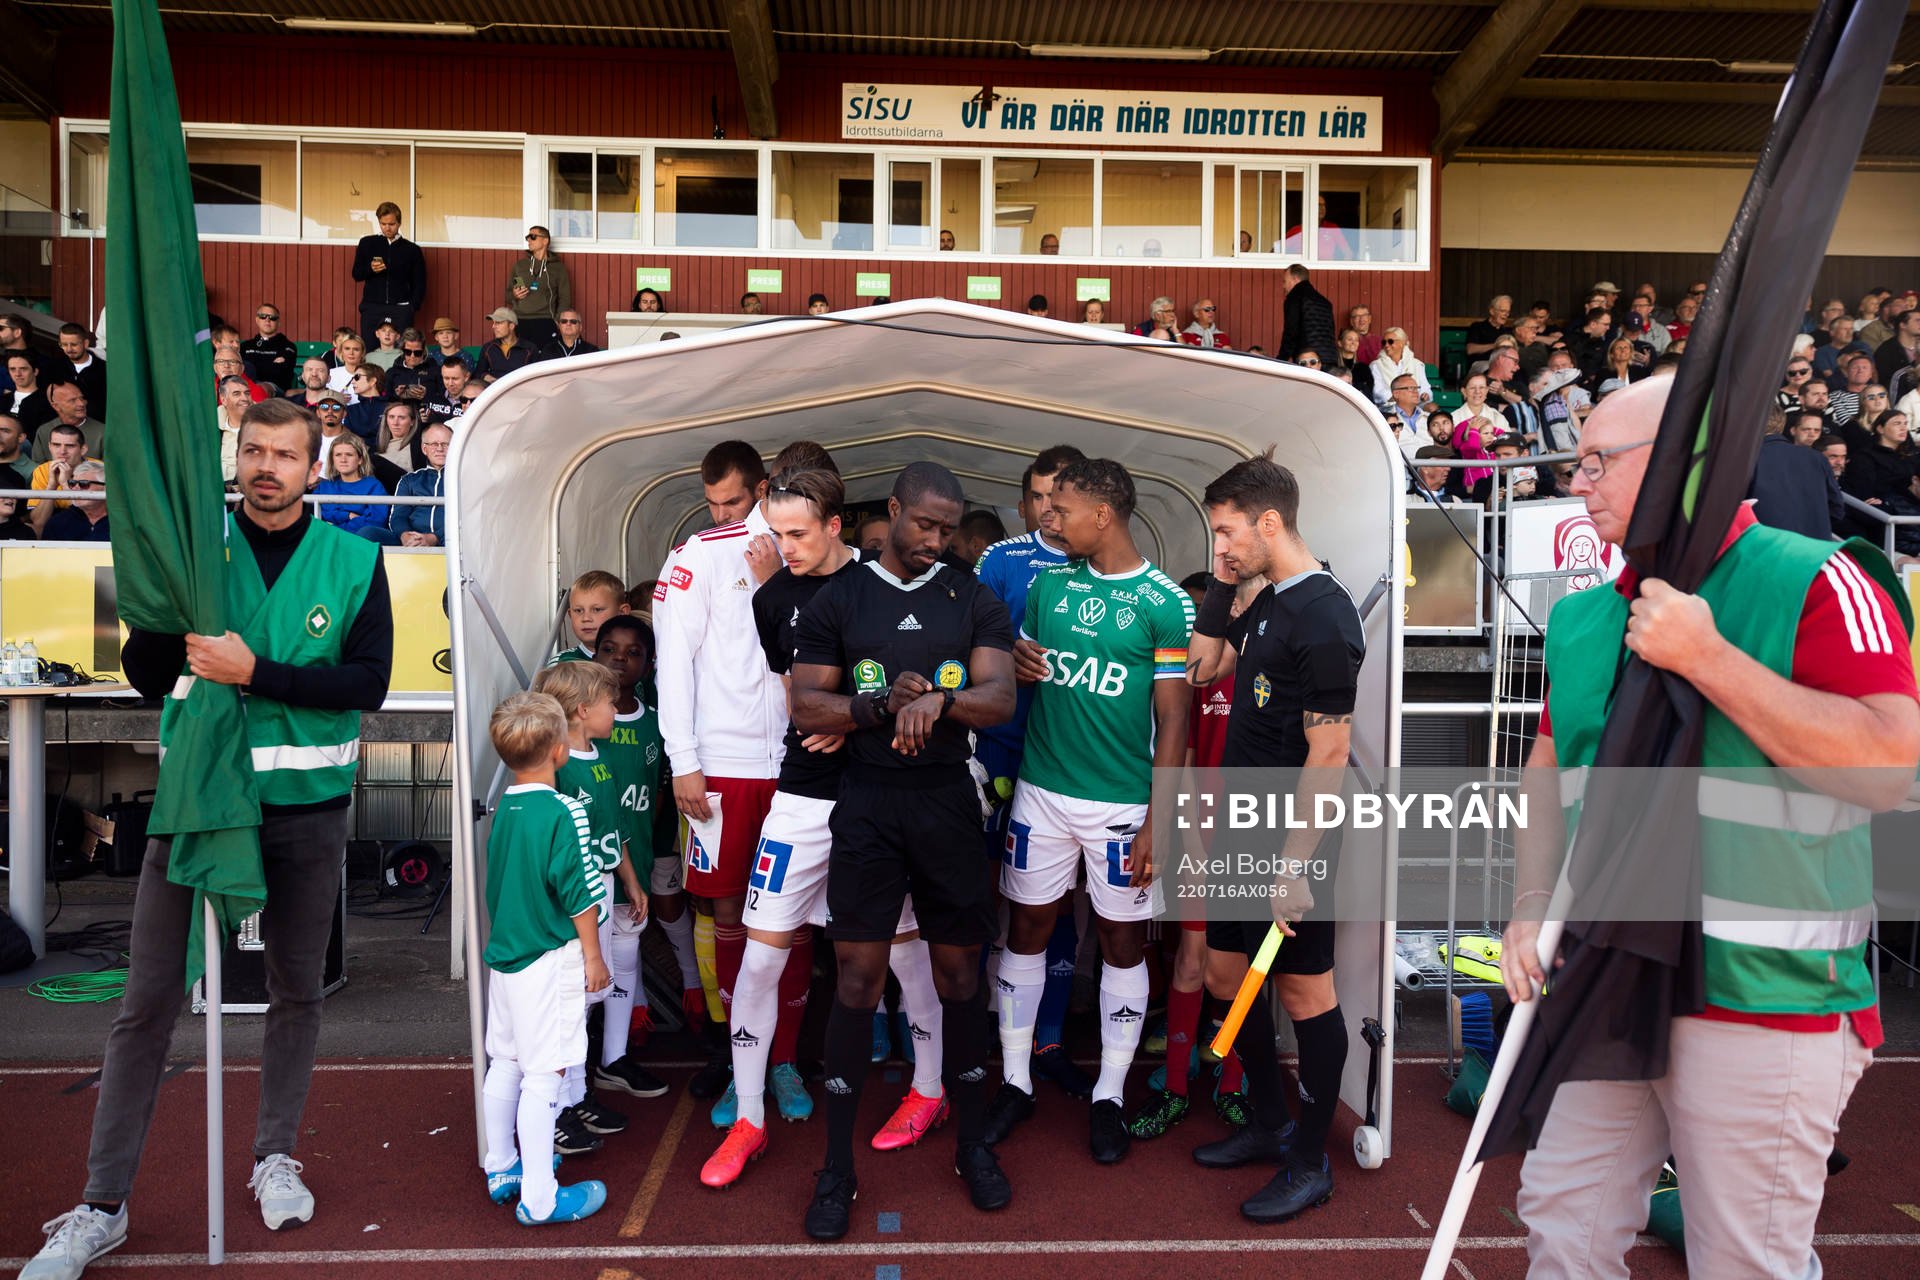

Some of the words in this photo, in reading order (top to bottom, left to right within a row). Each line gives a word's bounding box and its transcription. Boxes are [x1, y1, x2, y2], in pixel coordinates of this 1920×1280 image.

[961, 101, 987, 129] VI
[1000, 97, 1036, 130] ÄR
[1050, 98, 1104, 132] DÄR
[1116, 101, 1170, 133] NÄR
[1183, 107, 1306, 137] IDROTTEN
[1318, 105, 1367, 138] LÄR
[846, 125, 943, 138] Idrottsutbildarna
[639, 274, 668, 284] PRESS
[750, 276, 779, 286] PRESS
[859, 279, 888, 289] PRESS
[970, 283, 998, 292] PRESS
[1079, 285, 1107, 294] PRESS
[1071, 625, 1098, 637] Borlänge
[610, 727, 638, 745] XXL
